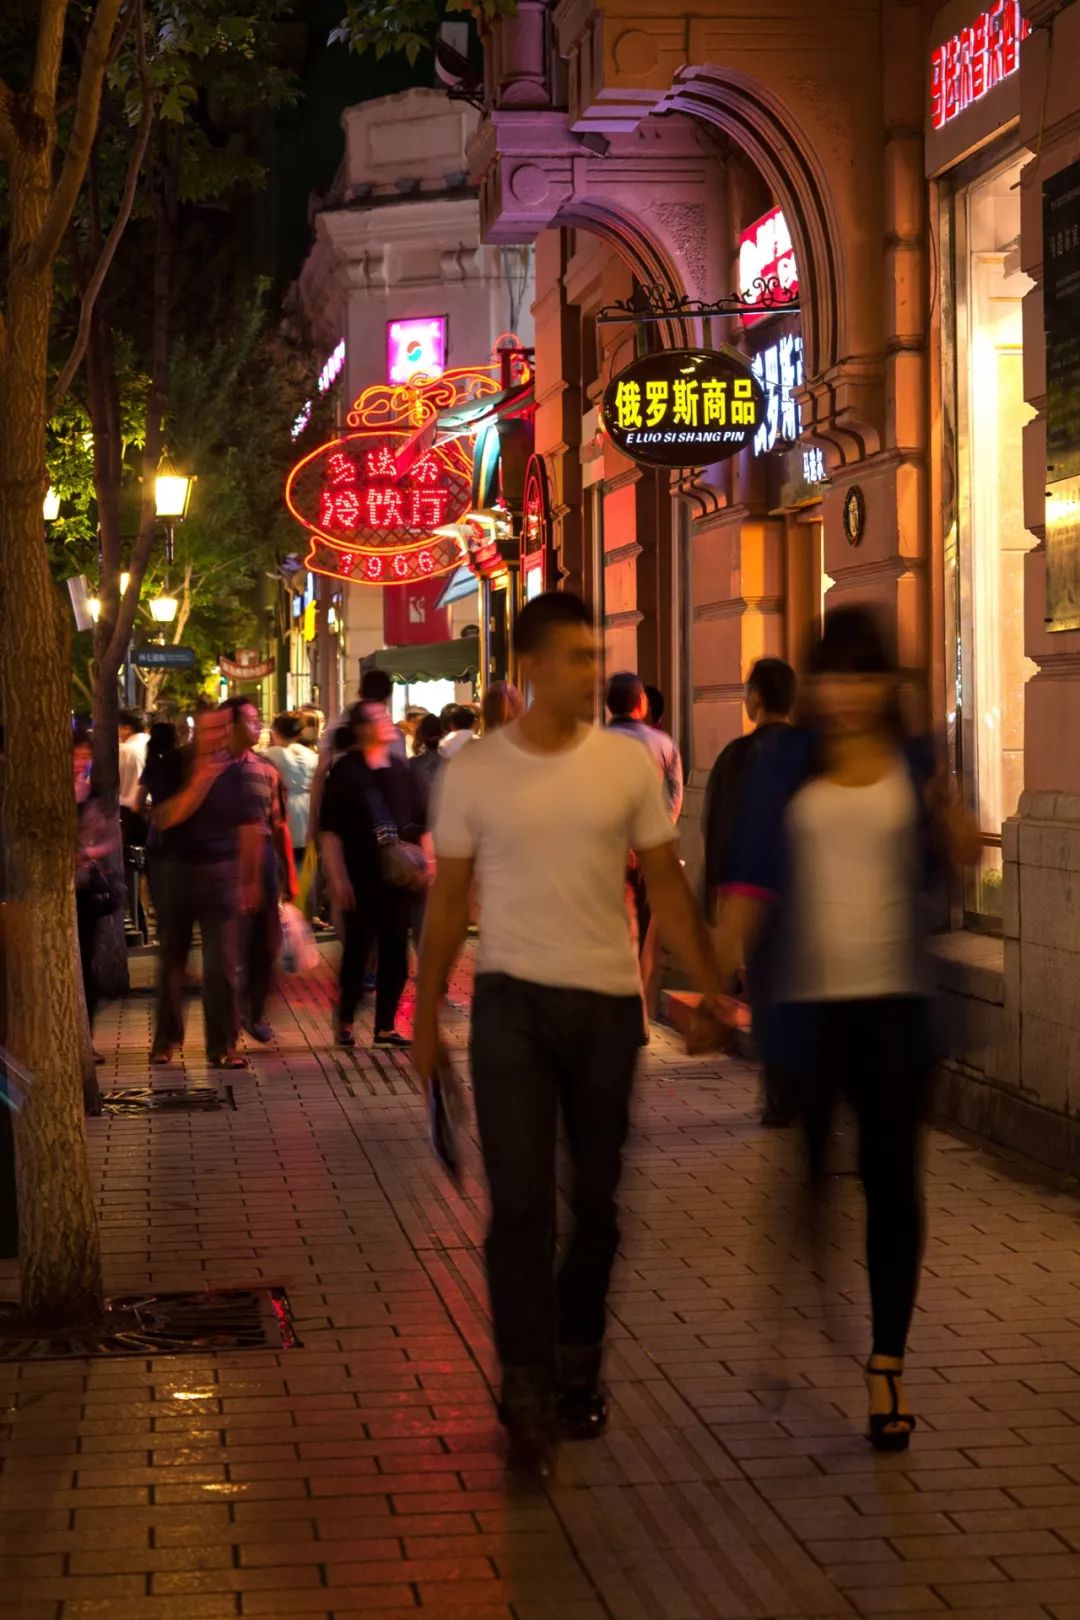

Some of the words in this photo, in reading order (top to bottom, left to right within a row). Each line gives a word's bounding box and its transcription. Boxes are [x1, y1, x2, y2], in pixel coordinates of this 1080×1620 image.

[615, 379, 755, 428] 俄罗斯商品
[626, 433, 635, 444] E
[636, 432, 662, 443] LUO
[663, 432, 676, 443] SI
[677, 431, 722, 443] SHANG
[723, 431, 745, 442] PIN
